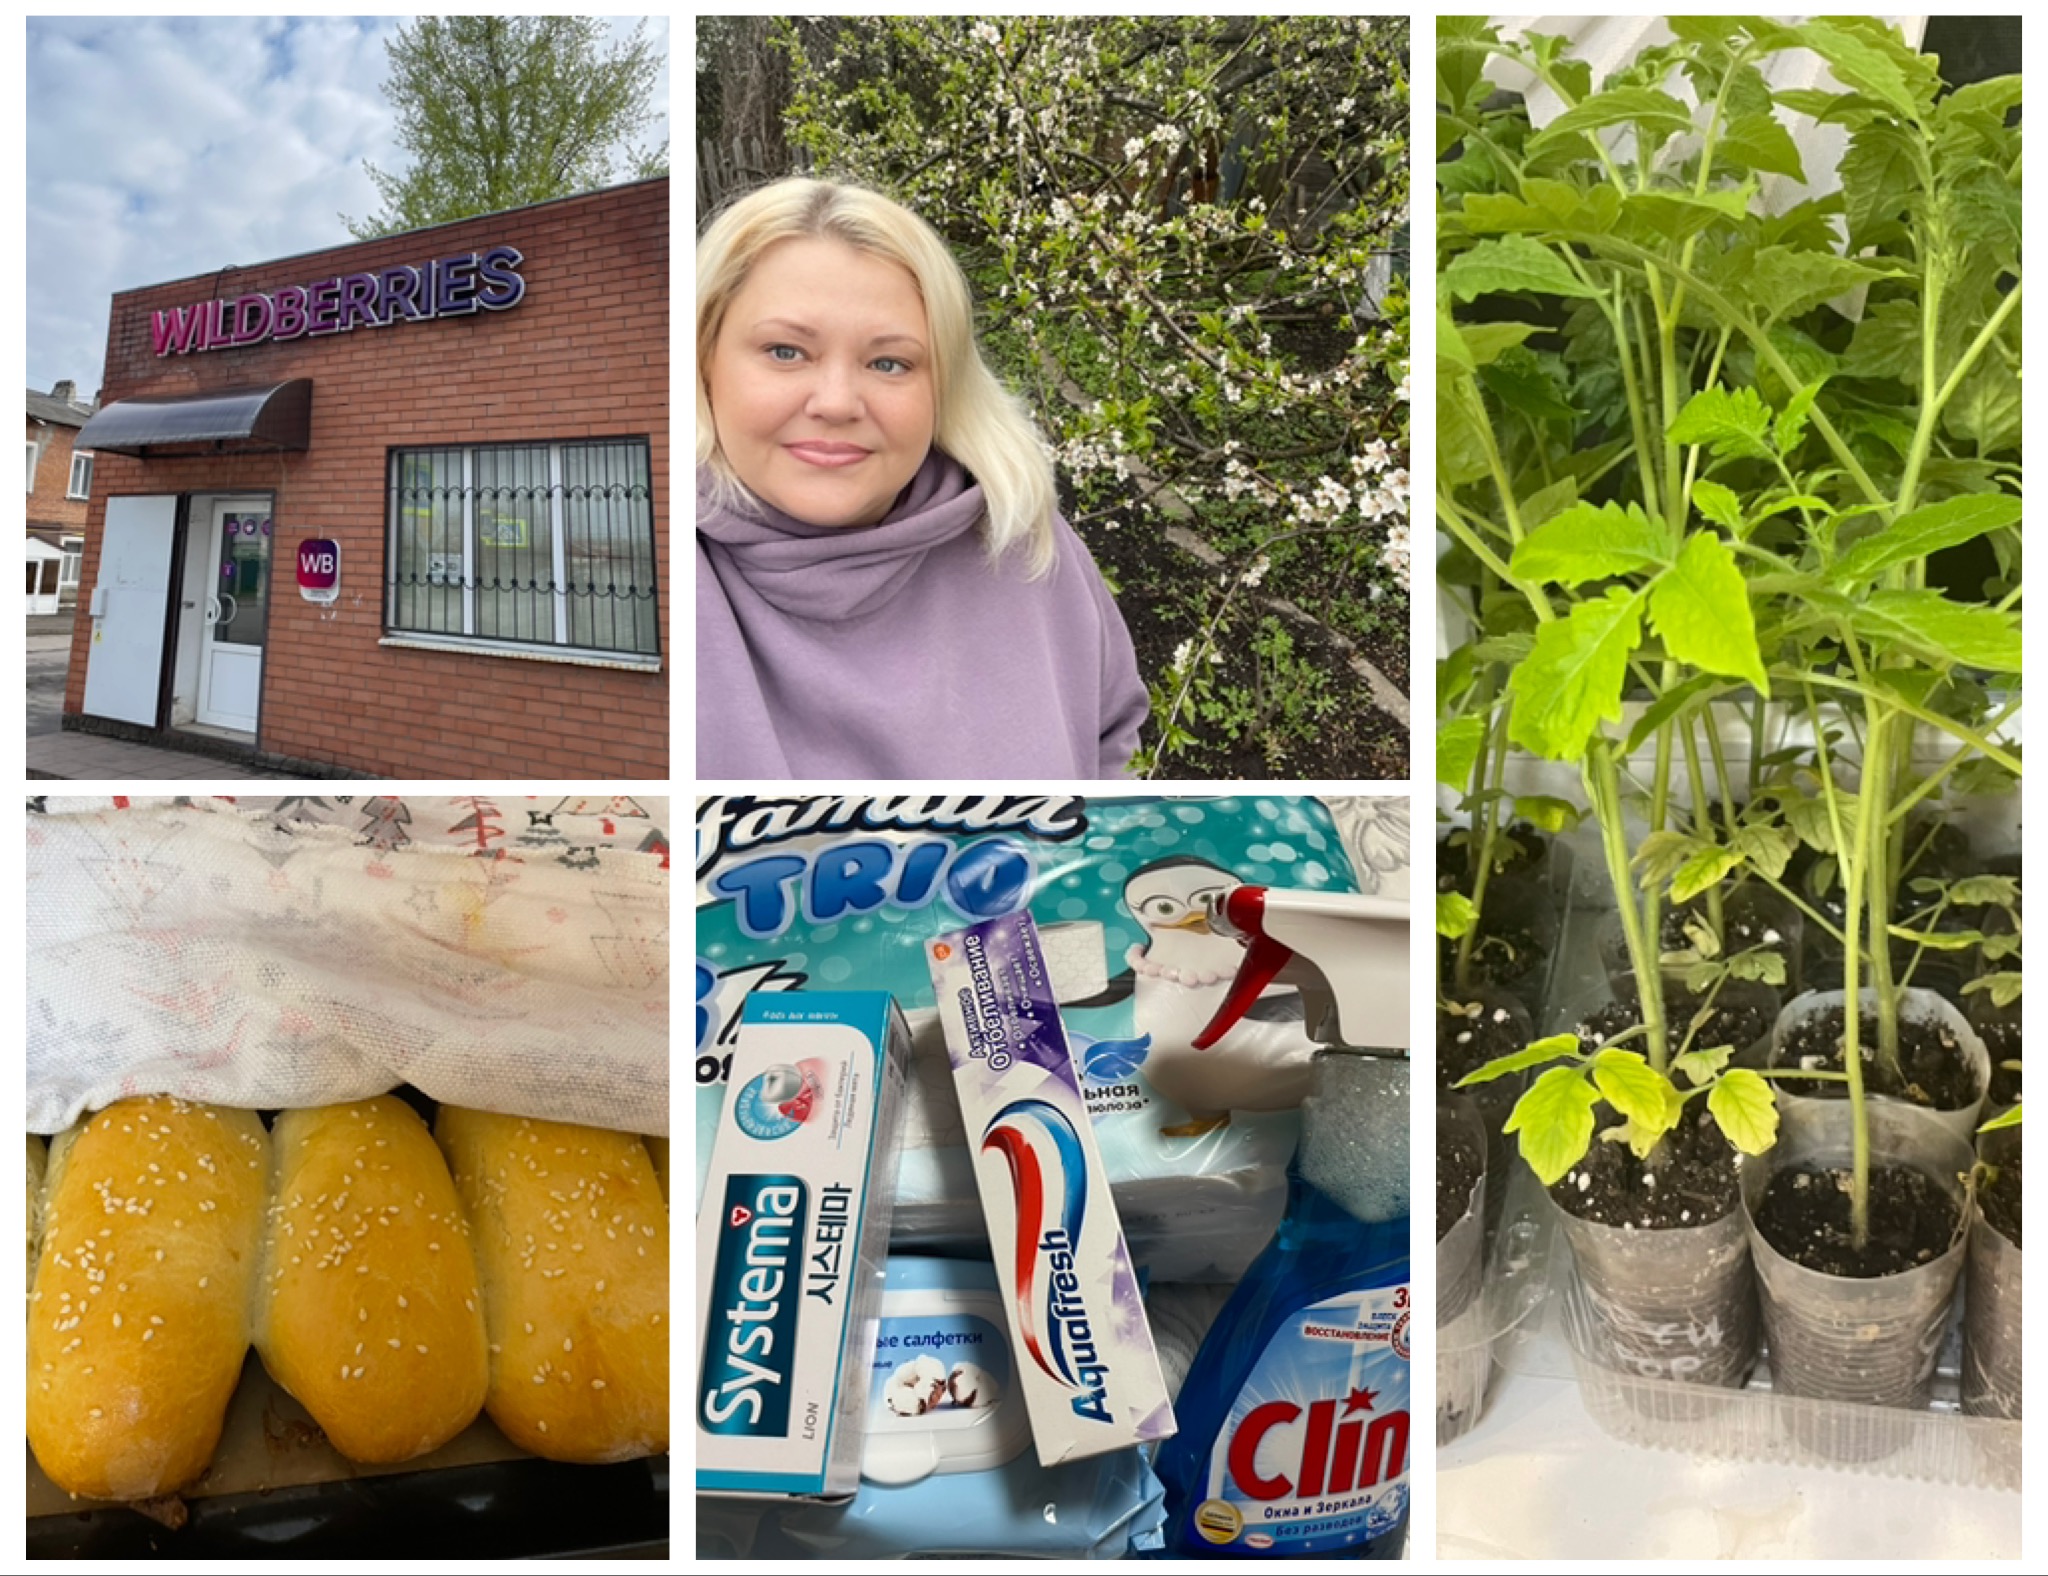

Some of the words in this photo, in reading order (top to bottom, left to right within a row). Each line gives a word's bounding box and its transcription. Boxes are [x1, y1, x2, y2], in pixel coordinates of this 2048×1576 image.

[149, 246, 526, 356] WILDBERRIES
[300, 552, 334, 574] WB
[712, 838, 1033, 936] TRIO
[965, 934, 1010, 1071] Отбеливание
[807, 1182, 852, 1305] 시스테마
[705, 1186, 799, 1425] Systema
[904, 1330, 983, 1350] салфетки
[1039, 1229, 1114, 1425] Aquafresh
[1304, 1325, 1390, 1342] ВОССТАНОВЛЕНИЕ
[802, 1402, 819, 1441] LION
[1228, 1388, 1410, 1501] Clin
[1264, 1505, 1300, 1520] Окна
[1304, 1505, 1312, 1515] и
[1316, 1494, 1372, 1515] Зеркала
[1275, 1523, 1299, 1537] Без
